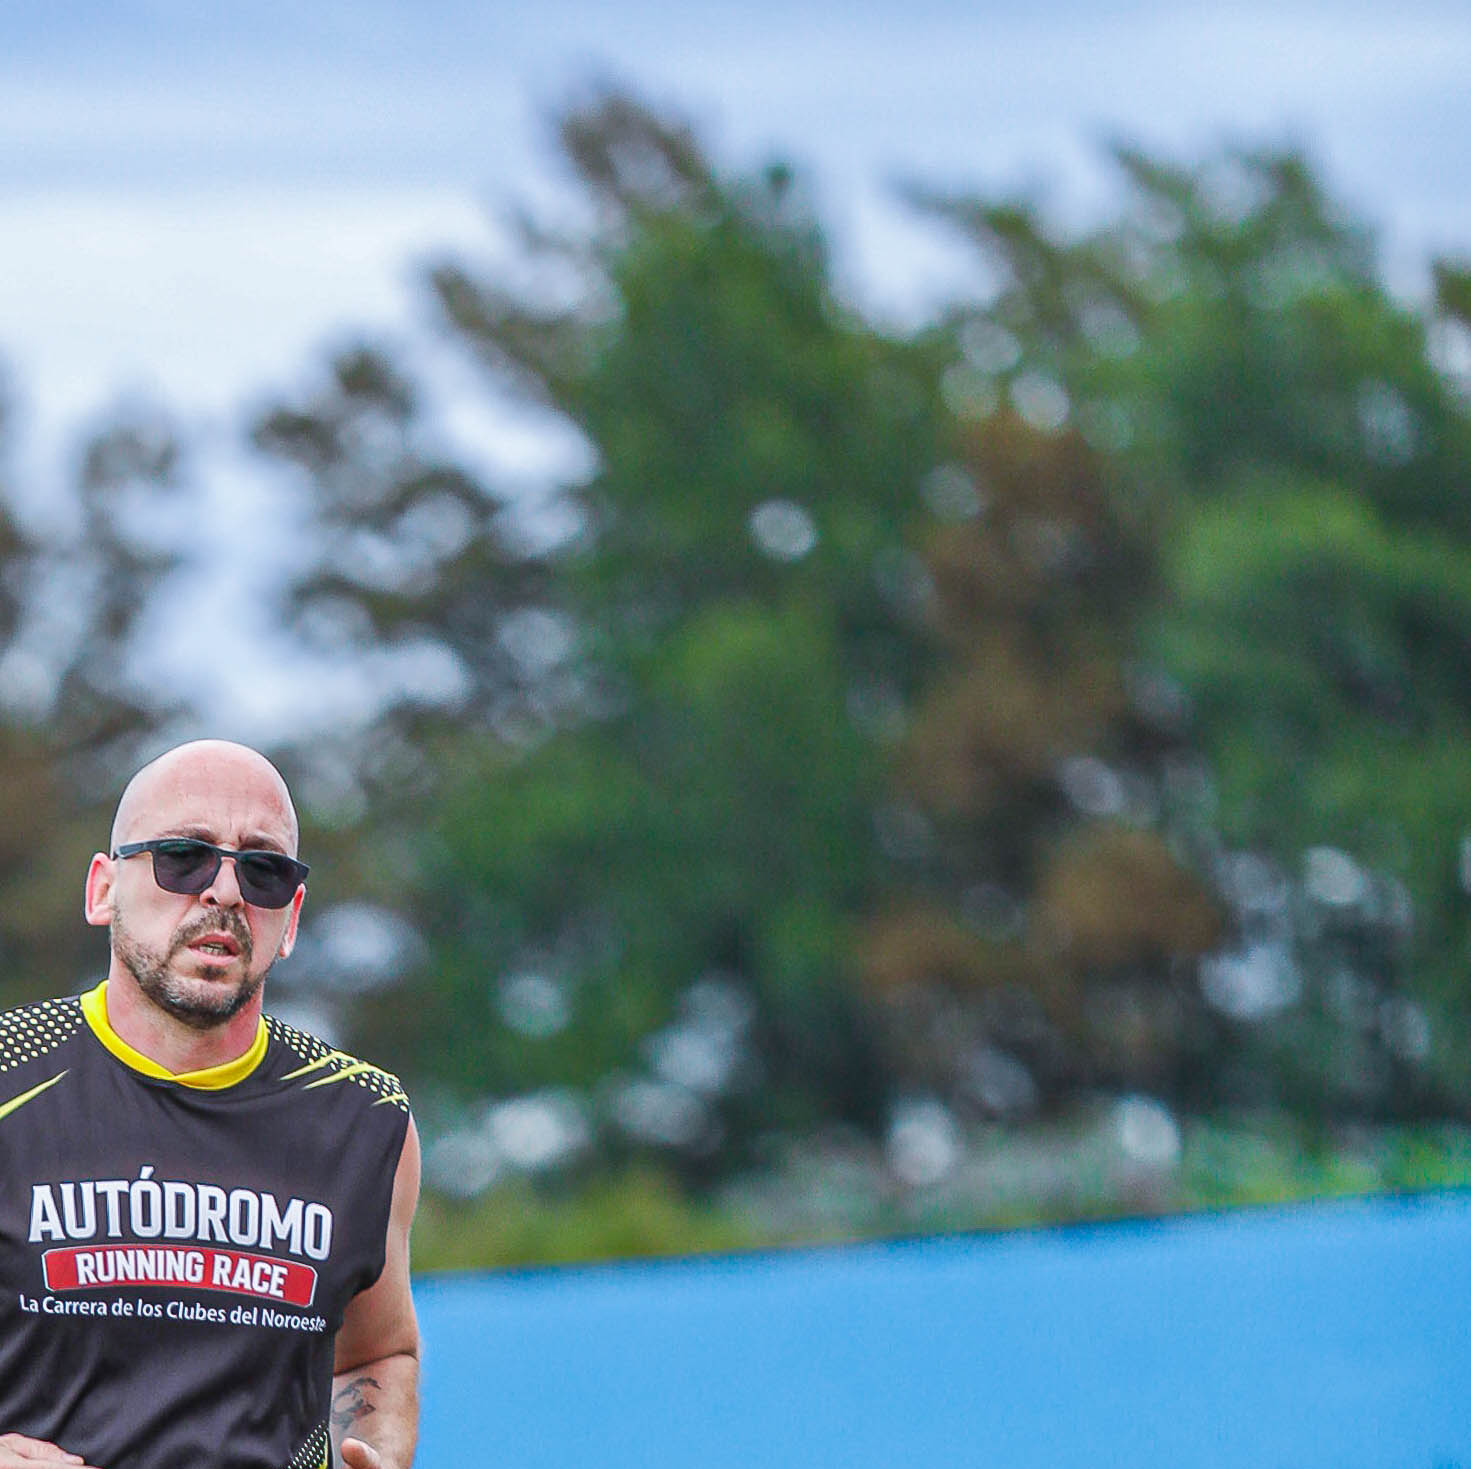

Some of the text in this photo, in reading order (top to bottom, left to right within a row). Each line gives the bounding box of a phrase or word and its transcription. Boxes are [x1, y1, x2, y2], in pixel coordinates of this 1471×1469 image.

[28, 1165, 333, 1261] AUTÓDROMO
[75, 1249, 288, 1299] RUNNING RACE
[19, 1294, 327, 1332] La Carrera de los Clubes del Noroeste
